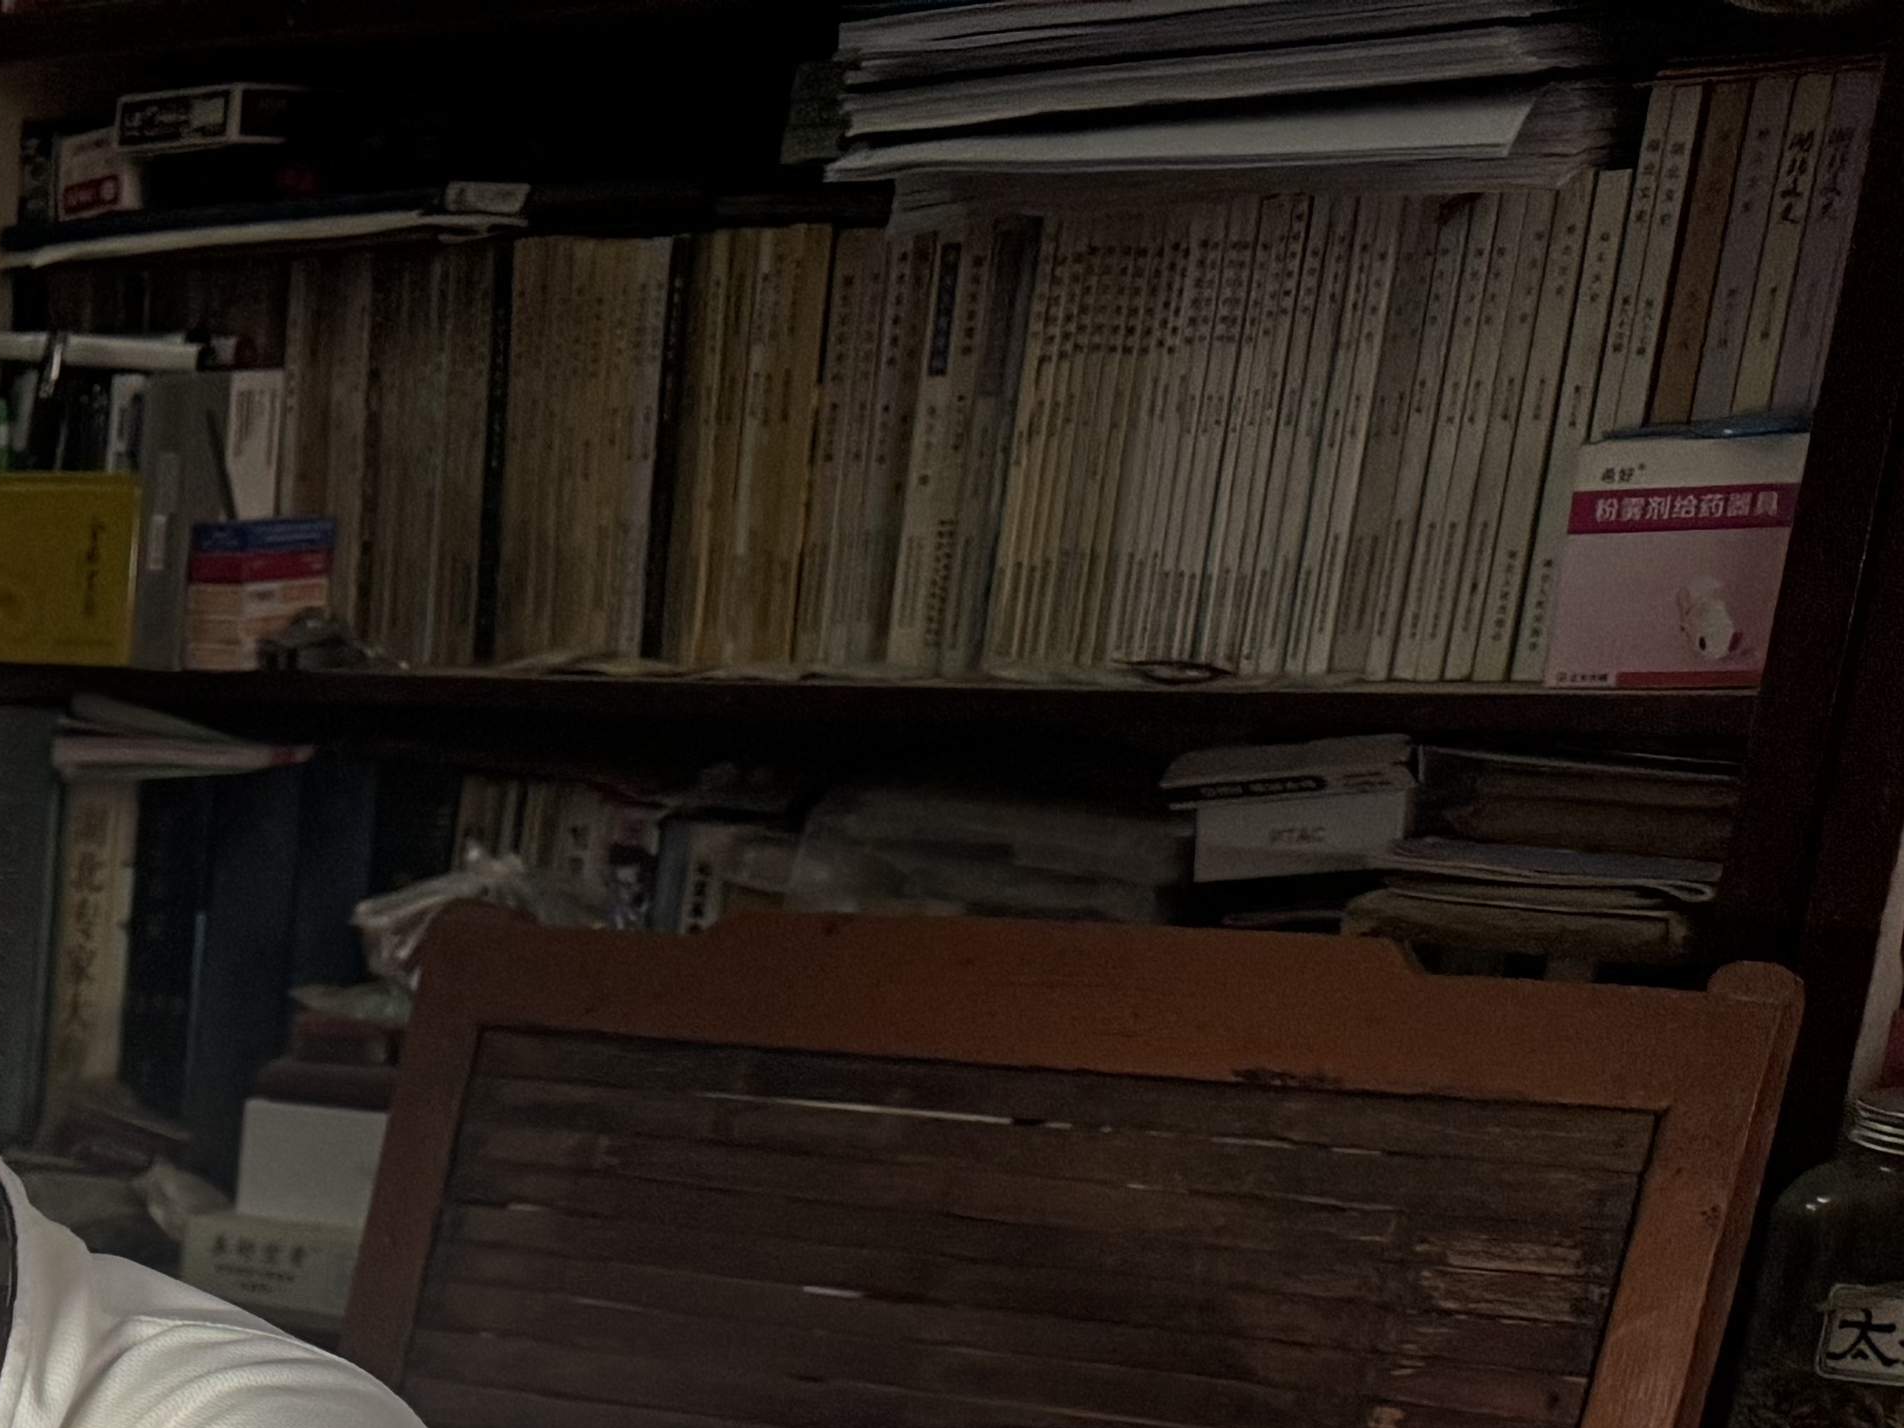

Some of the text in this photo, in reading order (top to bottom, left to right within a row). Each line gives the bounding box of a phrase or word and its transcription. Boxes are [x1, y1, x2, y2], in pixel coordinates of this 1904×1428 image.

[1595, 490, 1779, 522] 粉雾剂给药器具
[1826, 1307, 1904, 1367] 太
